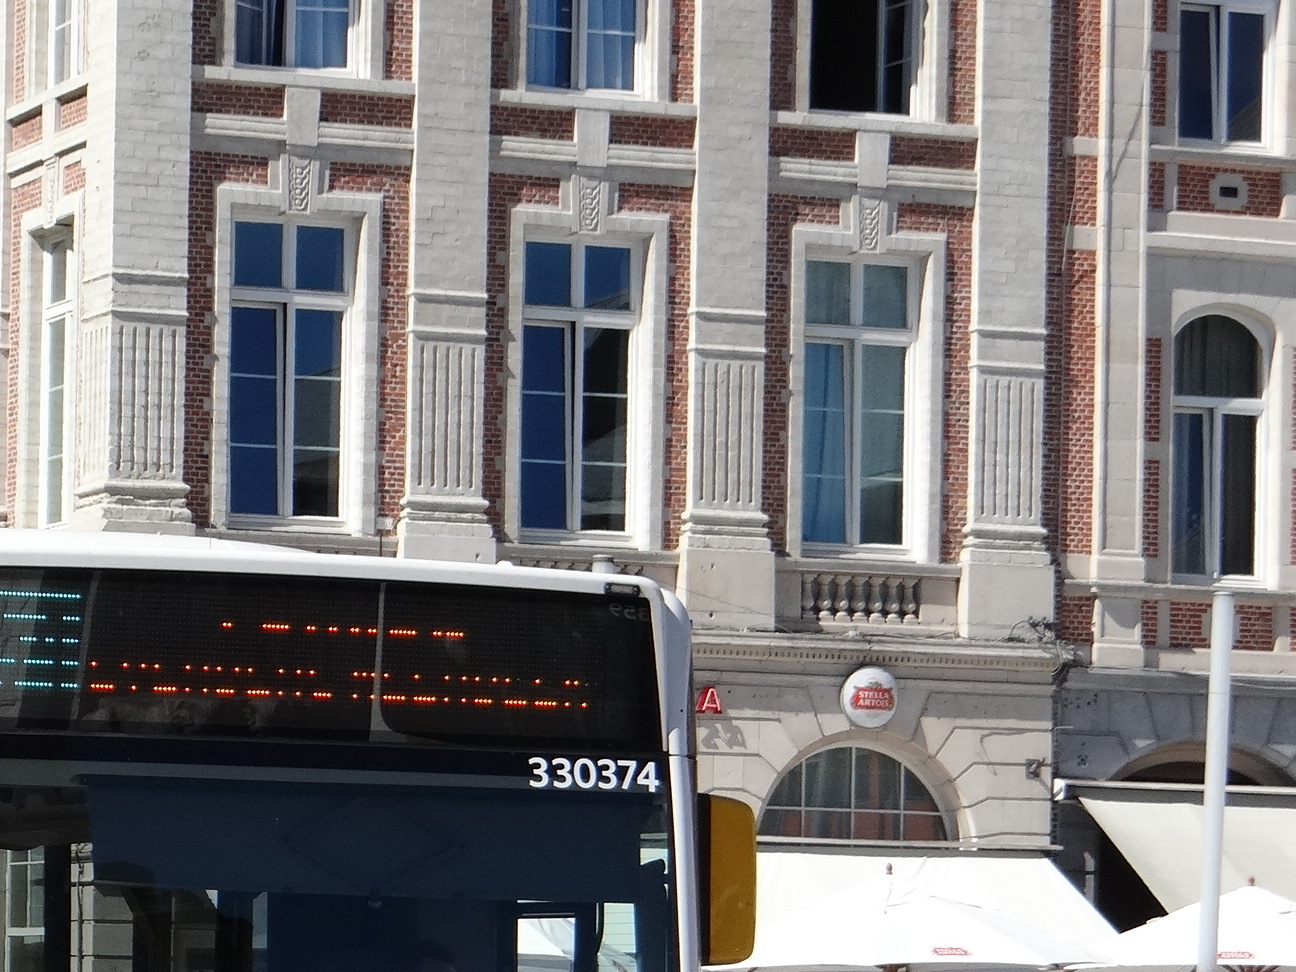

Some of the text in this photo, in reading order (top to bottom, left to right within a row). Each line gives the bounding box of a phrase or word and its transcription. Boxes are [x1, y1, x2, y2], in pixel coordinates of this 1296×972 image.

[858, 690, 890, 699] STELLA
[857, 699, 890, 707] ARTOIS
[527, 756, 660, 793] 330374
